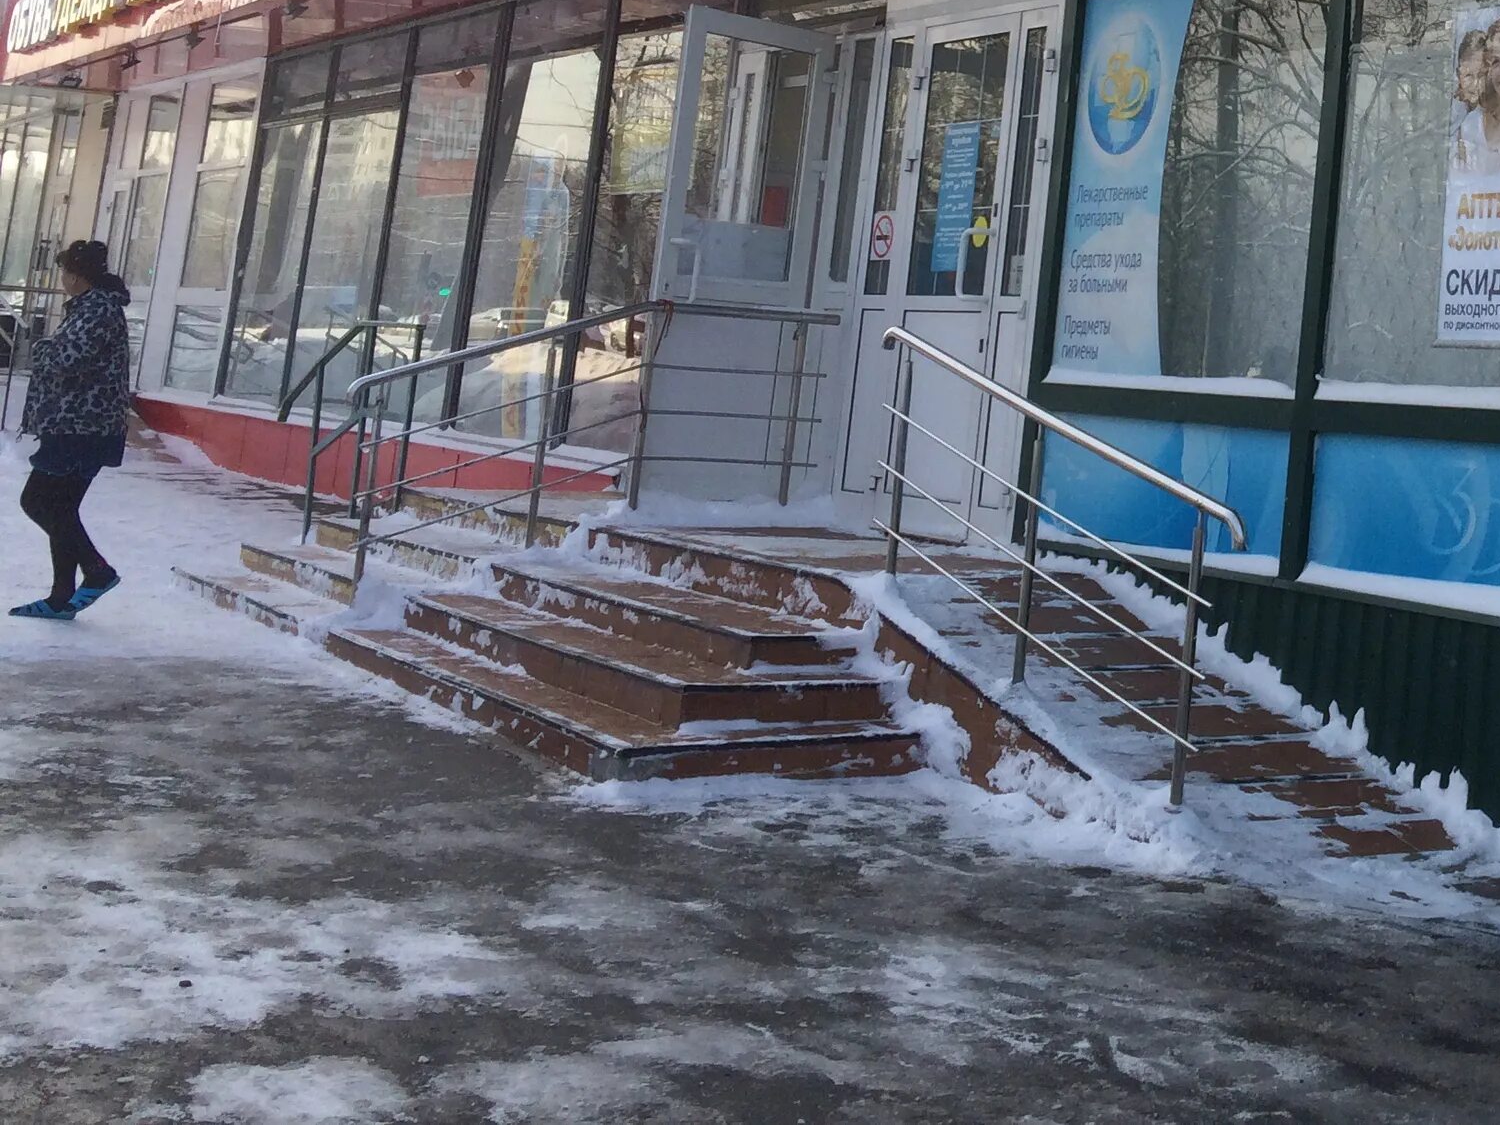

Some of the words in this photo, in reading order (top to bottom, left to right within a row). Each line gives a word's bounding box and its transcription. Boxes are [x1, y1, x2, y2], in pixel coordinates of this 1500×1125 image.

[1076, 184, 1149, 203] Лекарственные
[1074, 212, 1124, 231] препараты
[1070, 249, 1112, 271] Средства
[1114, 251, 1142, 274] ухода
[1068, 279, 1078, 293] за
[1080, 274, 1128, 294] больными
[1063, 315, 1112, 339] Предметы
[1061, 345, 1099, 360] гигиены
